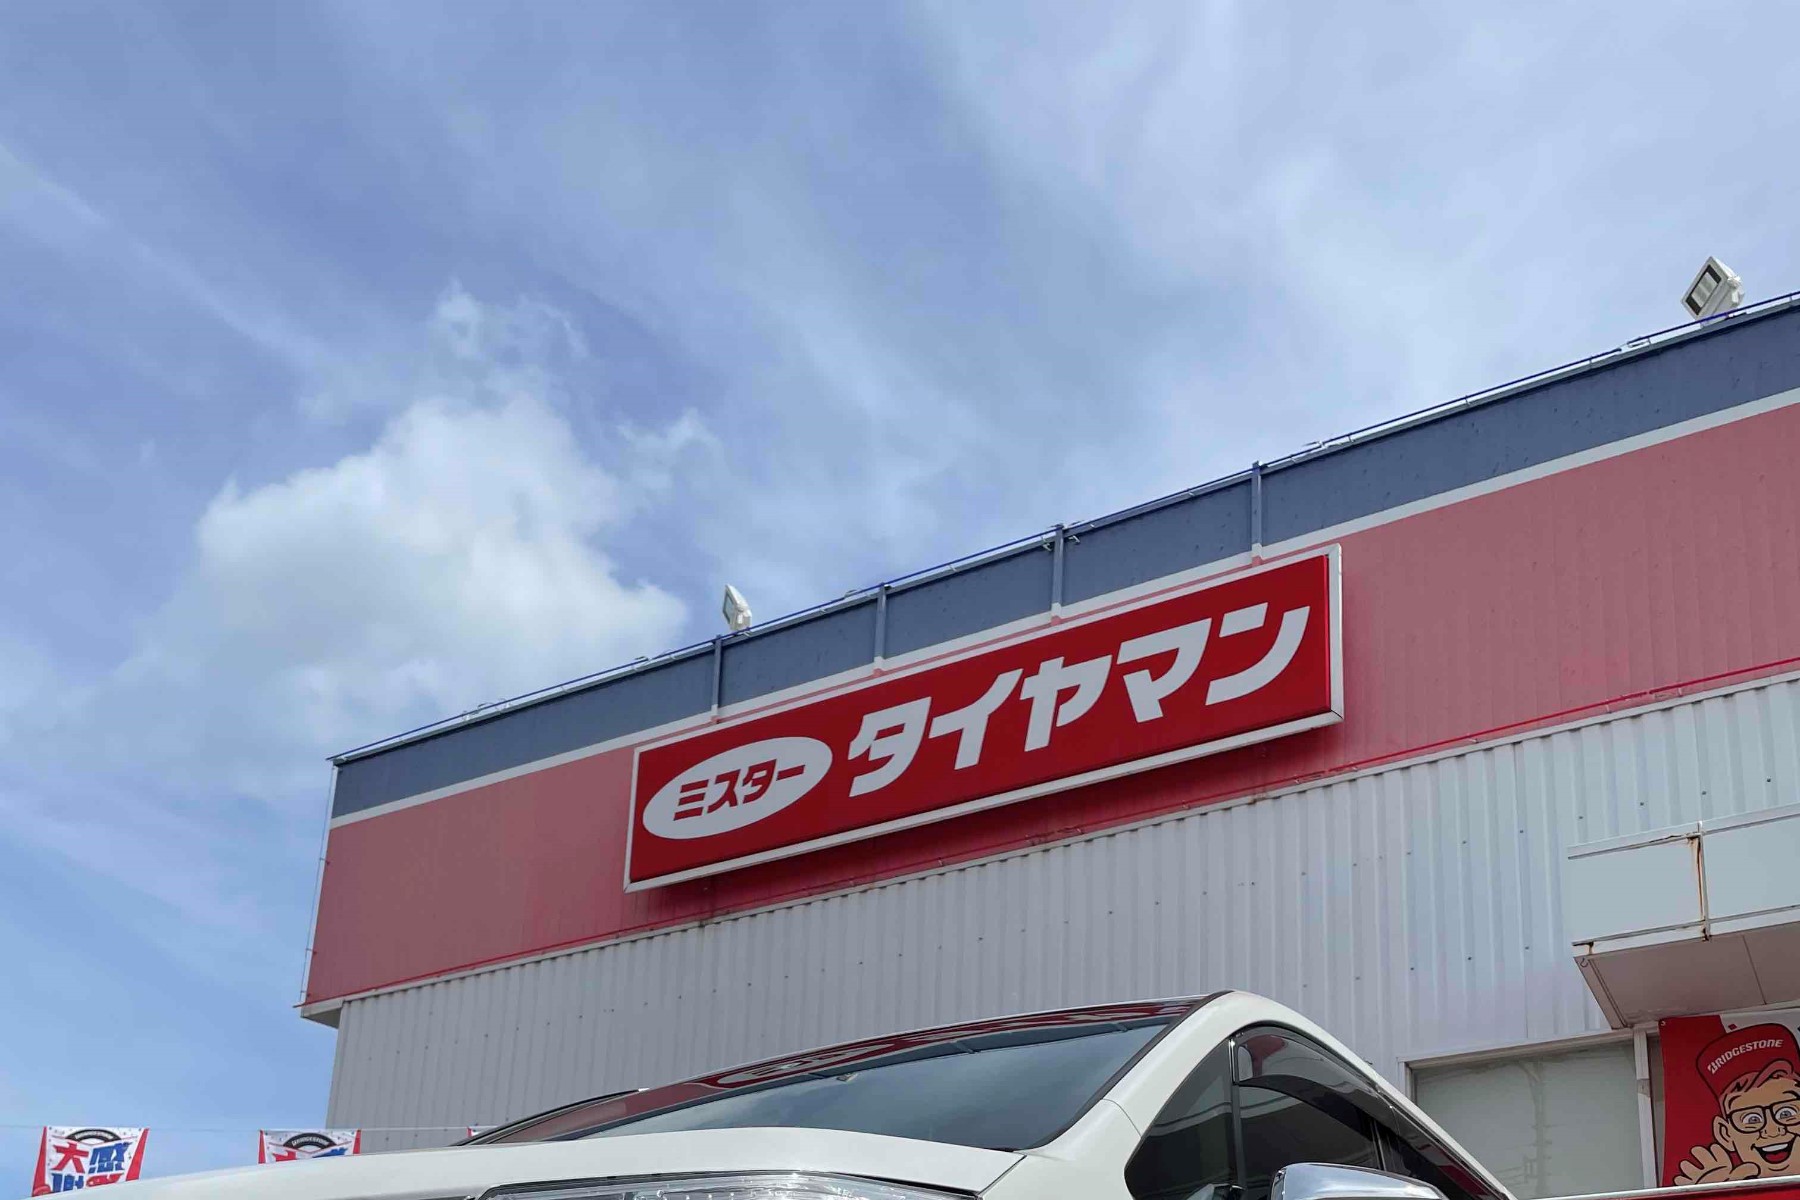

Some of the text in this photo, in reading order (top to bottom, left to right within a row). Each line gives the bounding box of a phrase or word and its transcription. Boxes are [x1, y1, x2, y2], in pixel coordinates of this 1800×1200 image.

[673, 602, 1310, 822] ミスター タイヤマン
[1707, 1039, 1784, 1075] BRIDGESTONE
